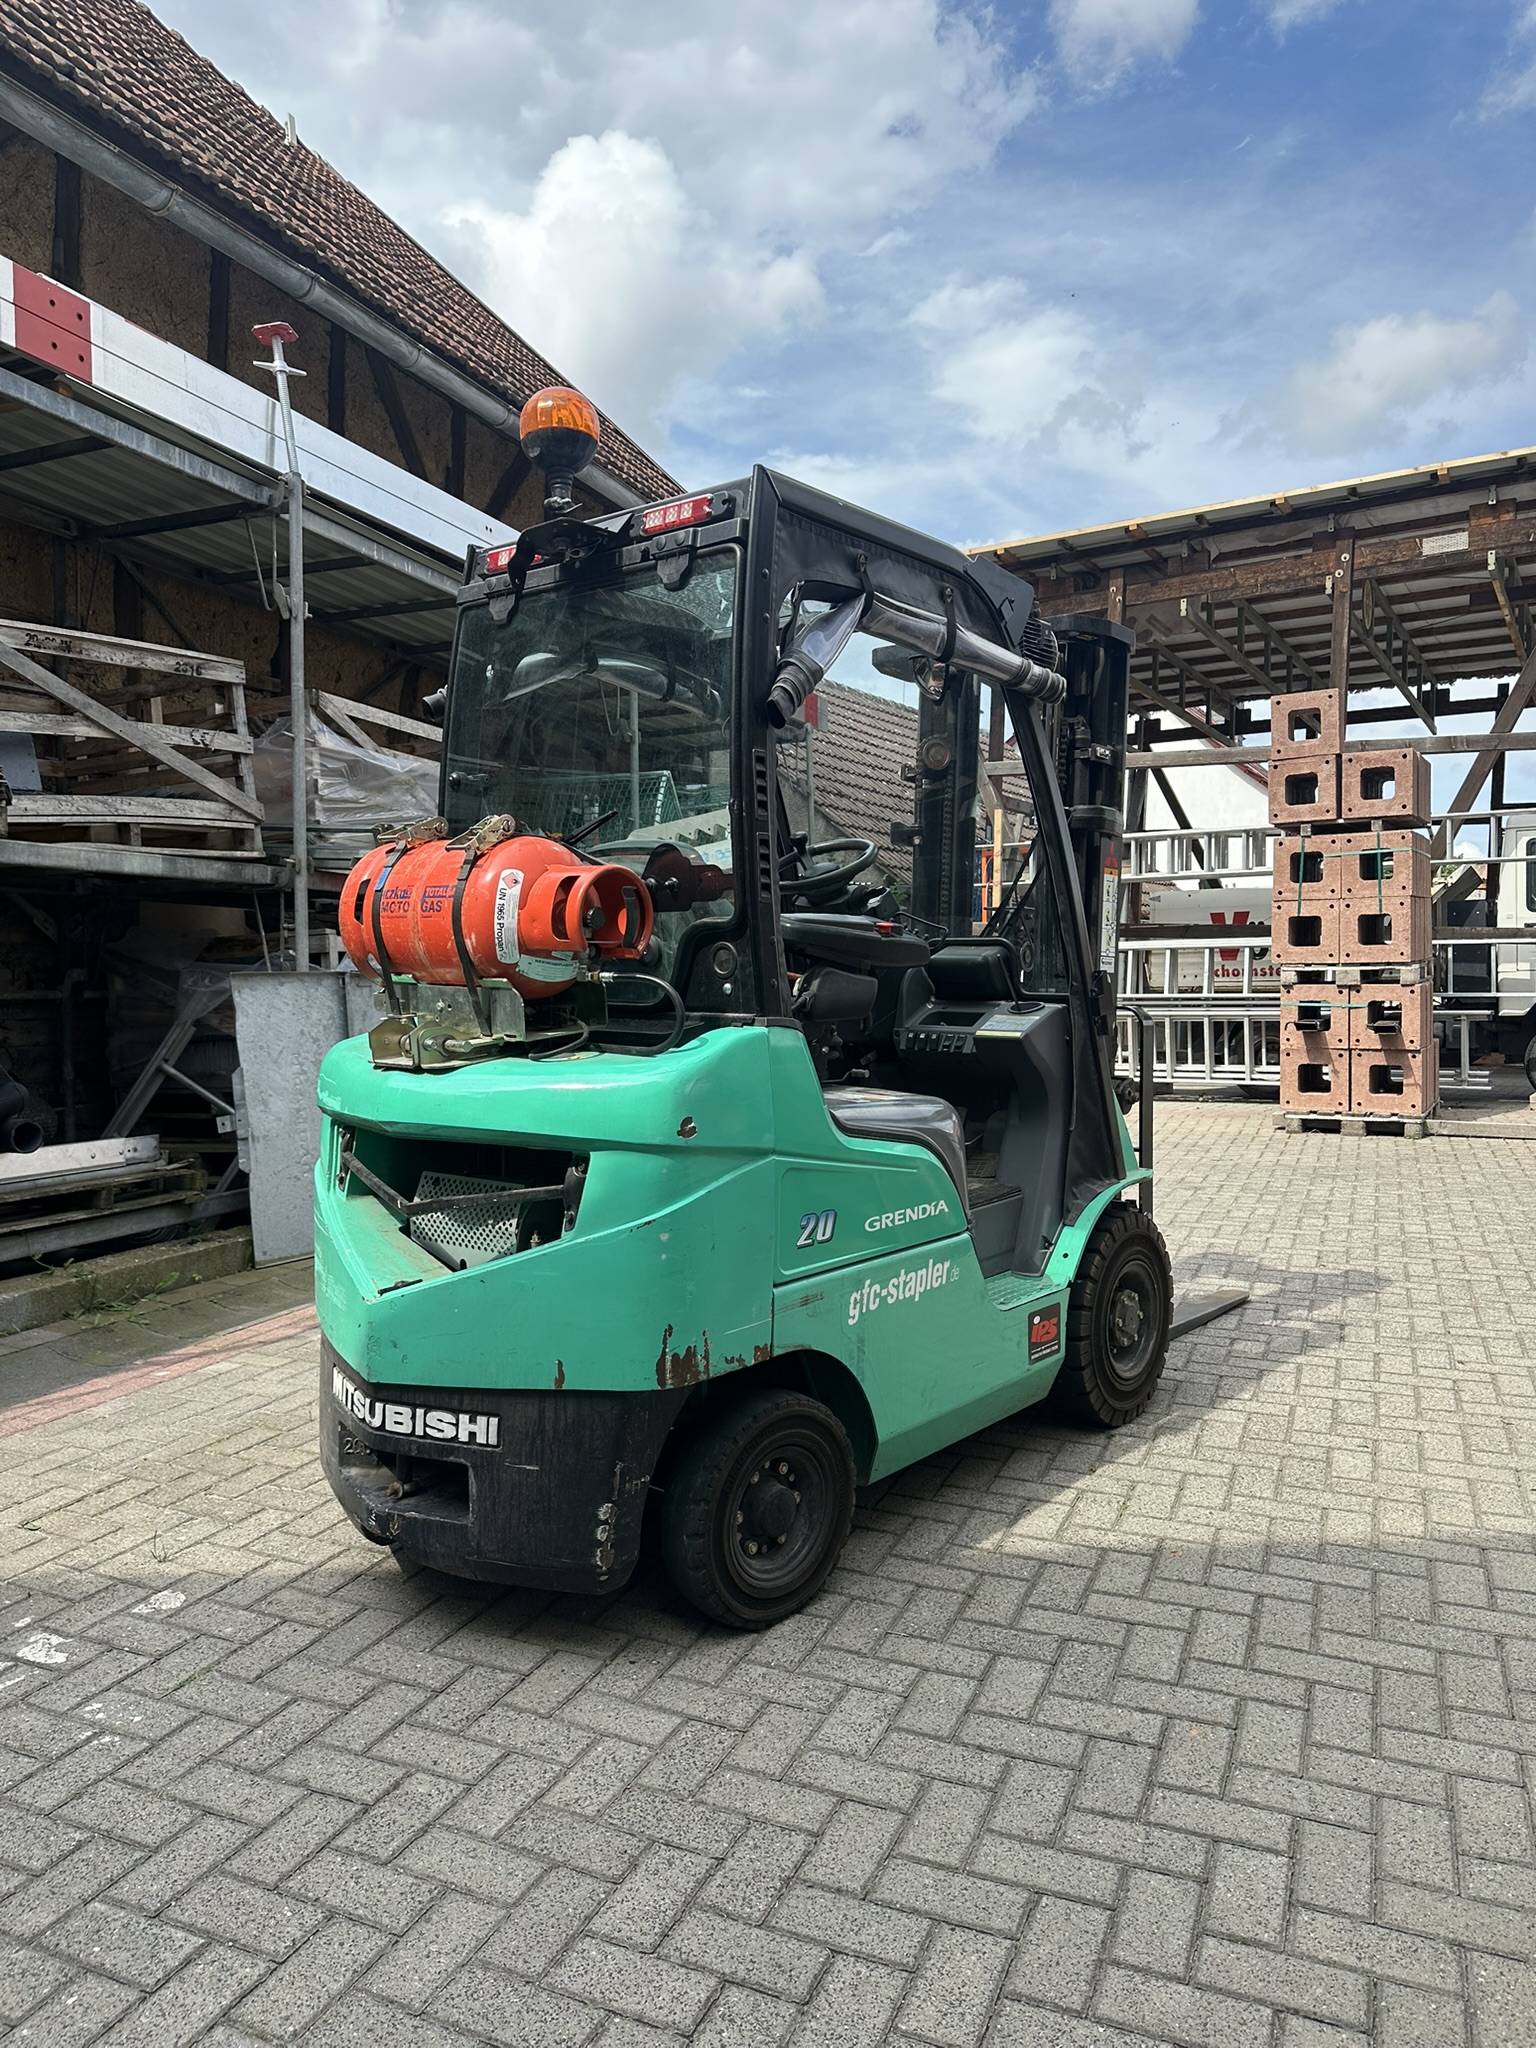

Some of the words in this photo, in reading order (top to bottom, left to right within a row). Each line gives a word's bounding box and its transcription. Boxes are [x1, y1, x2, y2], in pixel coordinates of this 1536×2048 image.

[498, 887, 507, 901] UN
[420, 900, 442, 913] GAS
[496, 902, 505, 921] 1965
[495, 922, 505, 952] Propan
[796, 1209, 837, 1249] 20
[332, 1365, 500, 1446] MITSUBISHI
